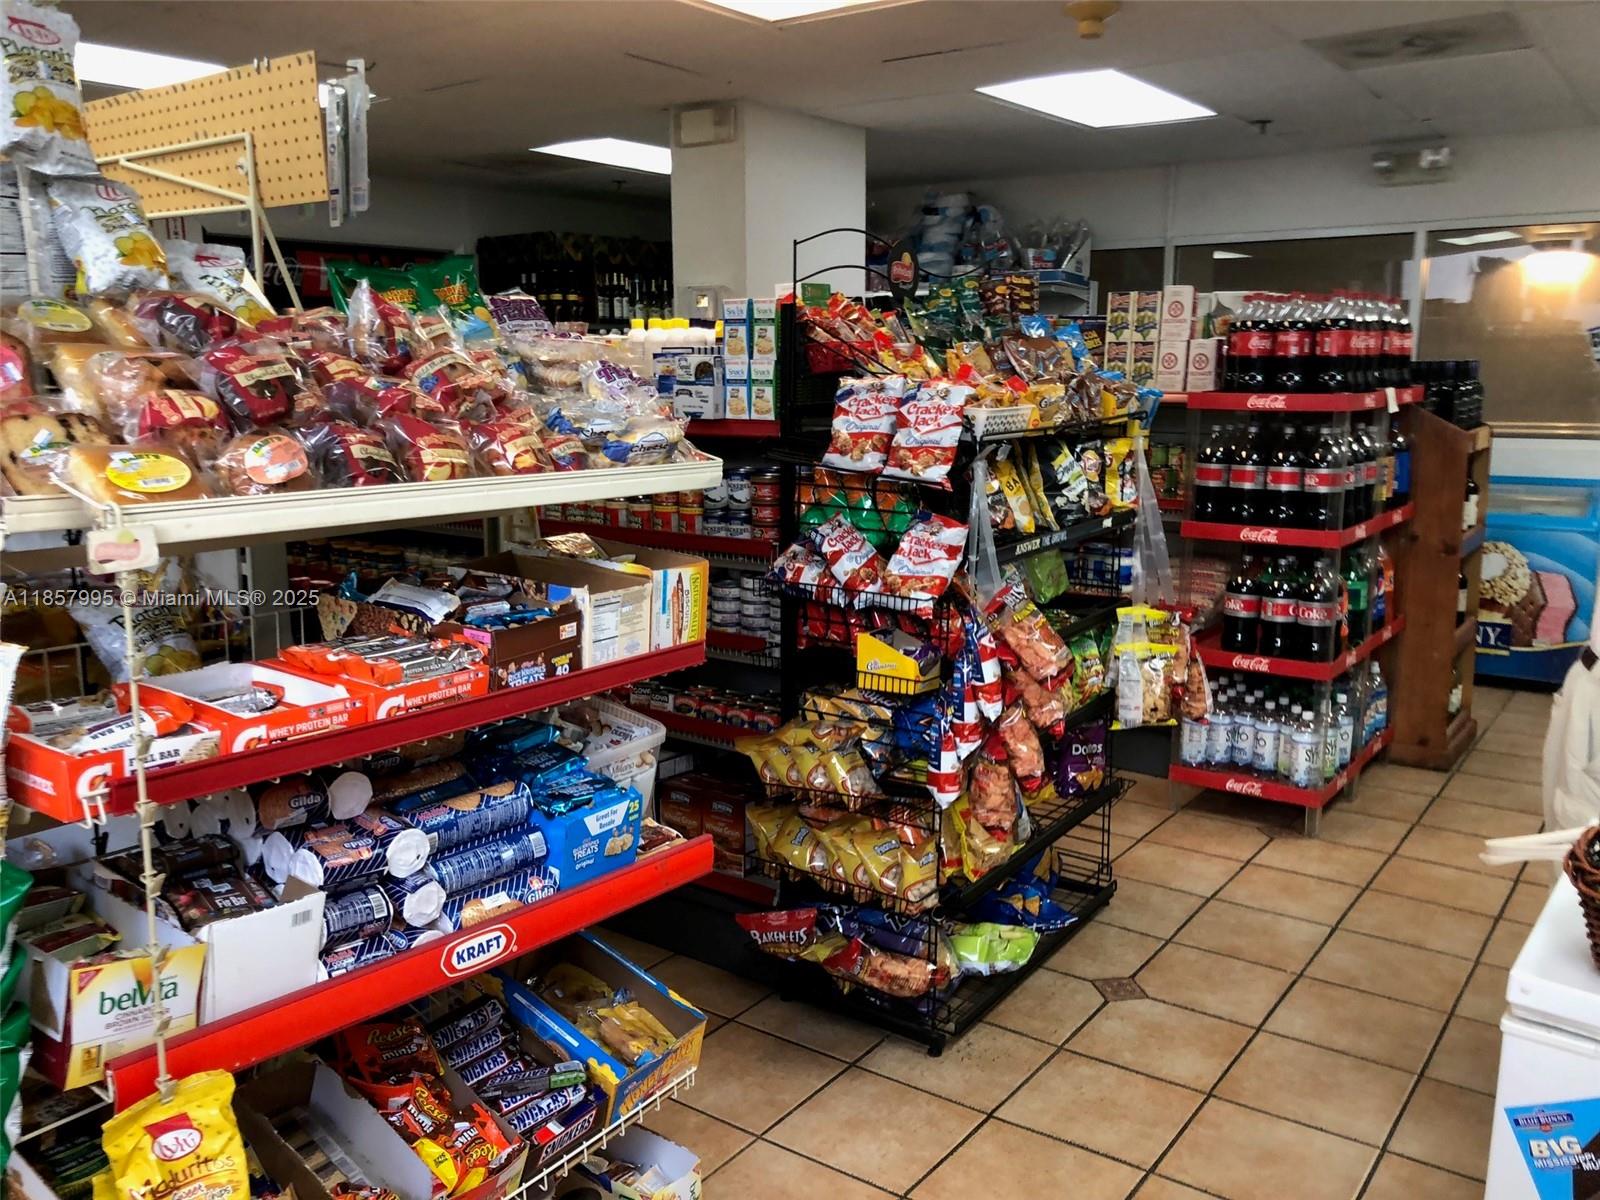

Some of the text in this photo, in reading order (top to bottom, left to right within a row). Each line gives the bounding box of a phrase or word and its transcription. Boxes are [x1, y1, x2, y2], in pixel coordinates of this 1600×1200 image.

[848, 393, 898, 408] Cracker
[1246, 394, 1288, 409] Coca-Cola
[854, 404, 881, 417] Jack
[907, 402, 962, 417] Cracker
[845, 420, 881, 431] Original
[905, 434, 943, 446] Original
[630, 442, 669, 454] Cheese
[1239, 527, 1279, 544] Coca-Cola
[1015, 539, 1041, 556] ANSWER
[1224, 599, 1244, 611] oke
[1298, 606, 1328, 621] Coke
[555, 663, 570, 677] 40
[1232, 654, 1271, 673] Coca-Cola
[406, 683, 472, 708] WHEY PROTEIN BAR
[267, 713, 349, 740] WHEY PROTEIN BAR
[129, 749, 181, 768] FLL BAR
[1226, 778, 1263, 798] Coca-Cola
[290, 794, 322, 809] Gilda
[629, 800, 640, 814] 25
[595, 809, 619, 823] Great For
[599, 819, 616, 830] Resale
[343, 838, 373, 849] Gilda
[574, 845, 599, 861] TREATS
[575, 858, 595, 870] Original
[232, 896, 249, 907] Bar
[750, 927, 808, 945] BAKEN-ETS
[456, 935, 502, 965] KRAFT
[382, 1043, 418, 1060] minis
[448, 1027, 501, 1064] SNICKERS
[461, 1050, 506, 1084] NICKERS
[508, 1089, 569, 1131] SNICKERS
[544, 1113, 594, 1156] SNICKERS
[1528, 1135, 1582, 1159] BIG
